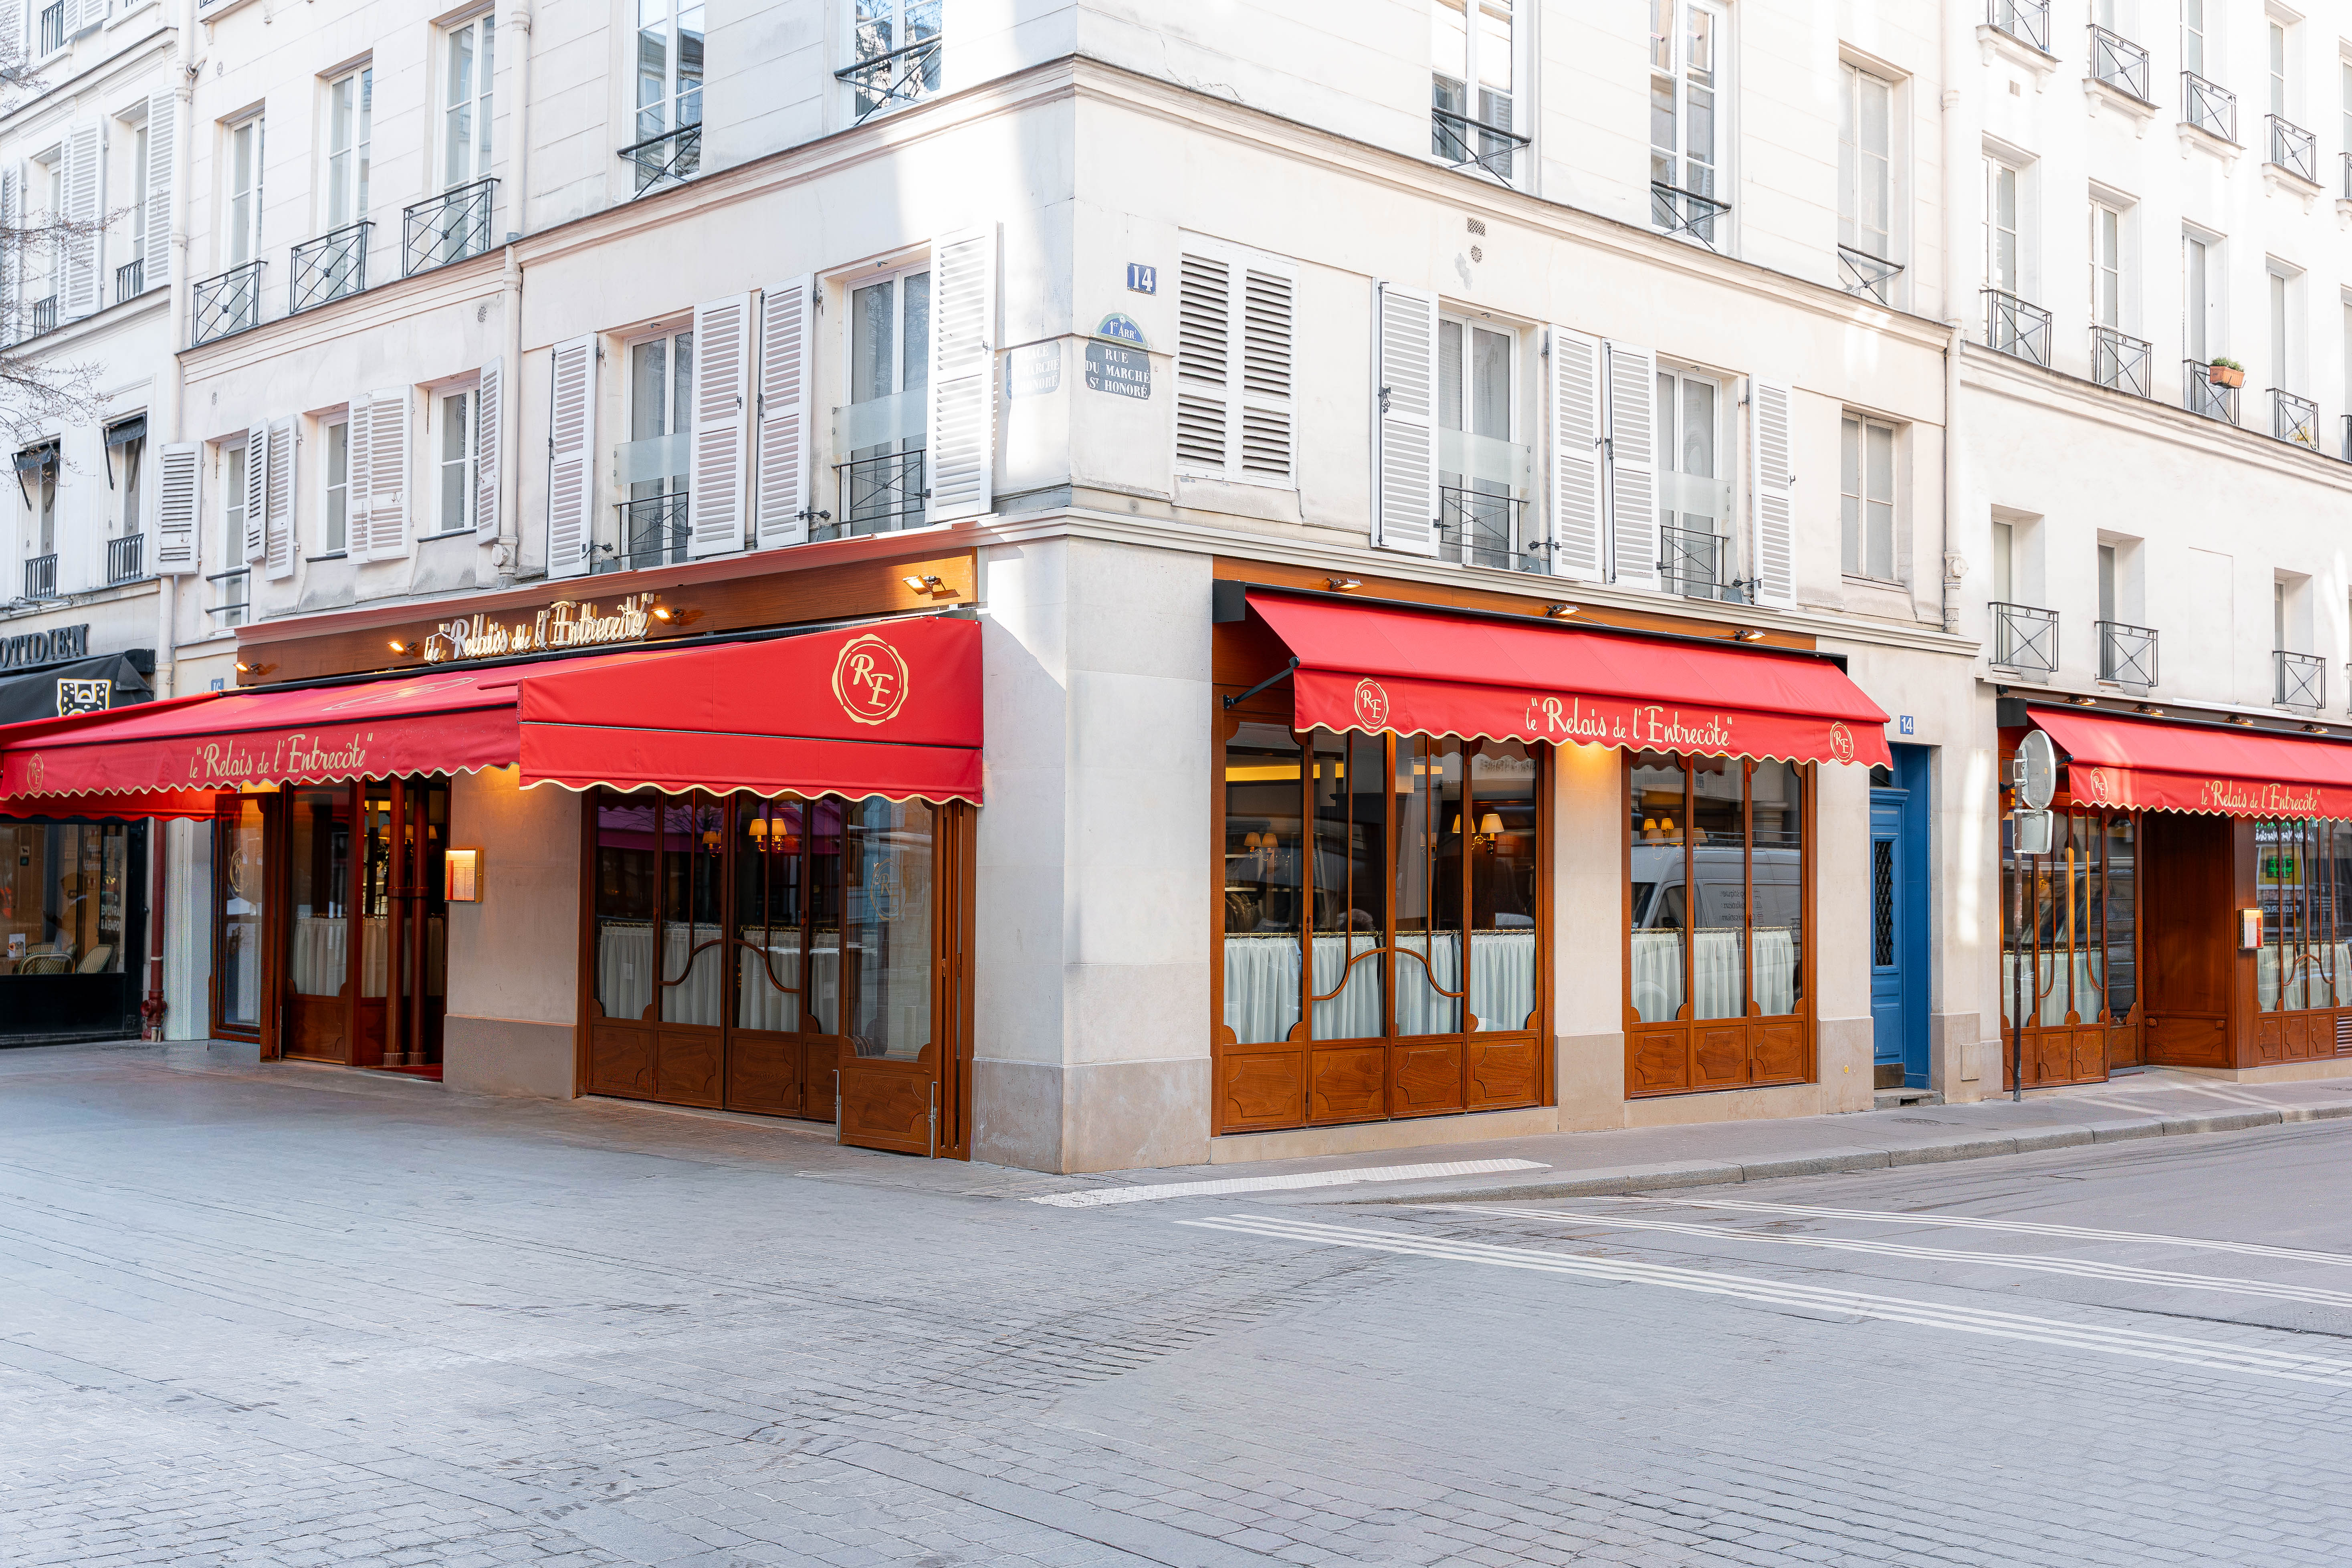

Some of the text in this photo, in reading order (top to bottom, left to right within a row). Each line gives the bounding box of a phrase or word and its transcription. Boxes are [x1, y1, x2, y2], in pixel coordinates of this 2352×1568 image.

[1133, 265, 1153, 292] 14
[1105, 348, 1128, 364] RUE
[1086, 360, 1151, 384] DU MARCHÉ
[1104, 379, 1148, 398] HONORÉ
[511, 623, 531, 652] de
[850, 654, 894, 707] RE
[1361, 689, 1382, 718] RE
[1526, 707, 1537, 731] le
[1613, 716, 1626, 739] de
[1901, 716, 1913, 733] 14
[1833, 731, 1849, 753] RE
[189, 757, 198, 779] le
[257, 751, 269, 774] de
[2093, 775, 2105, 796] RE
[2201, 788, 2208, 805] le
[2250, 792, 2258, 809] de
